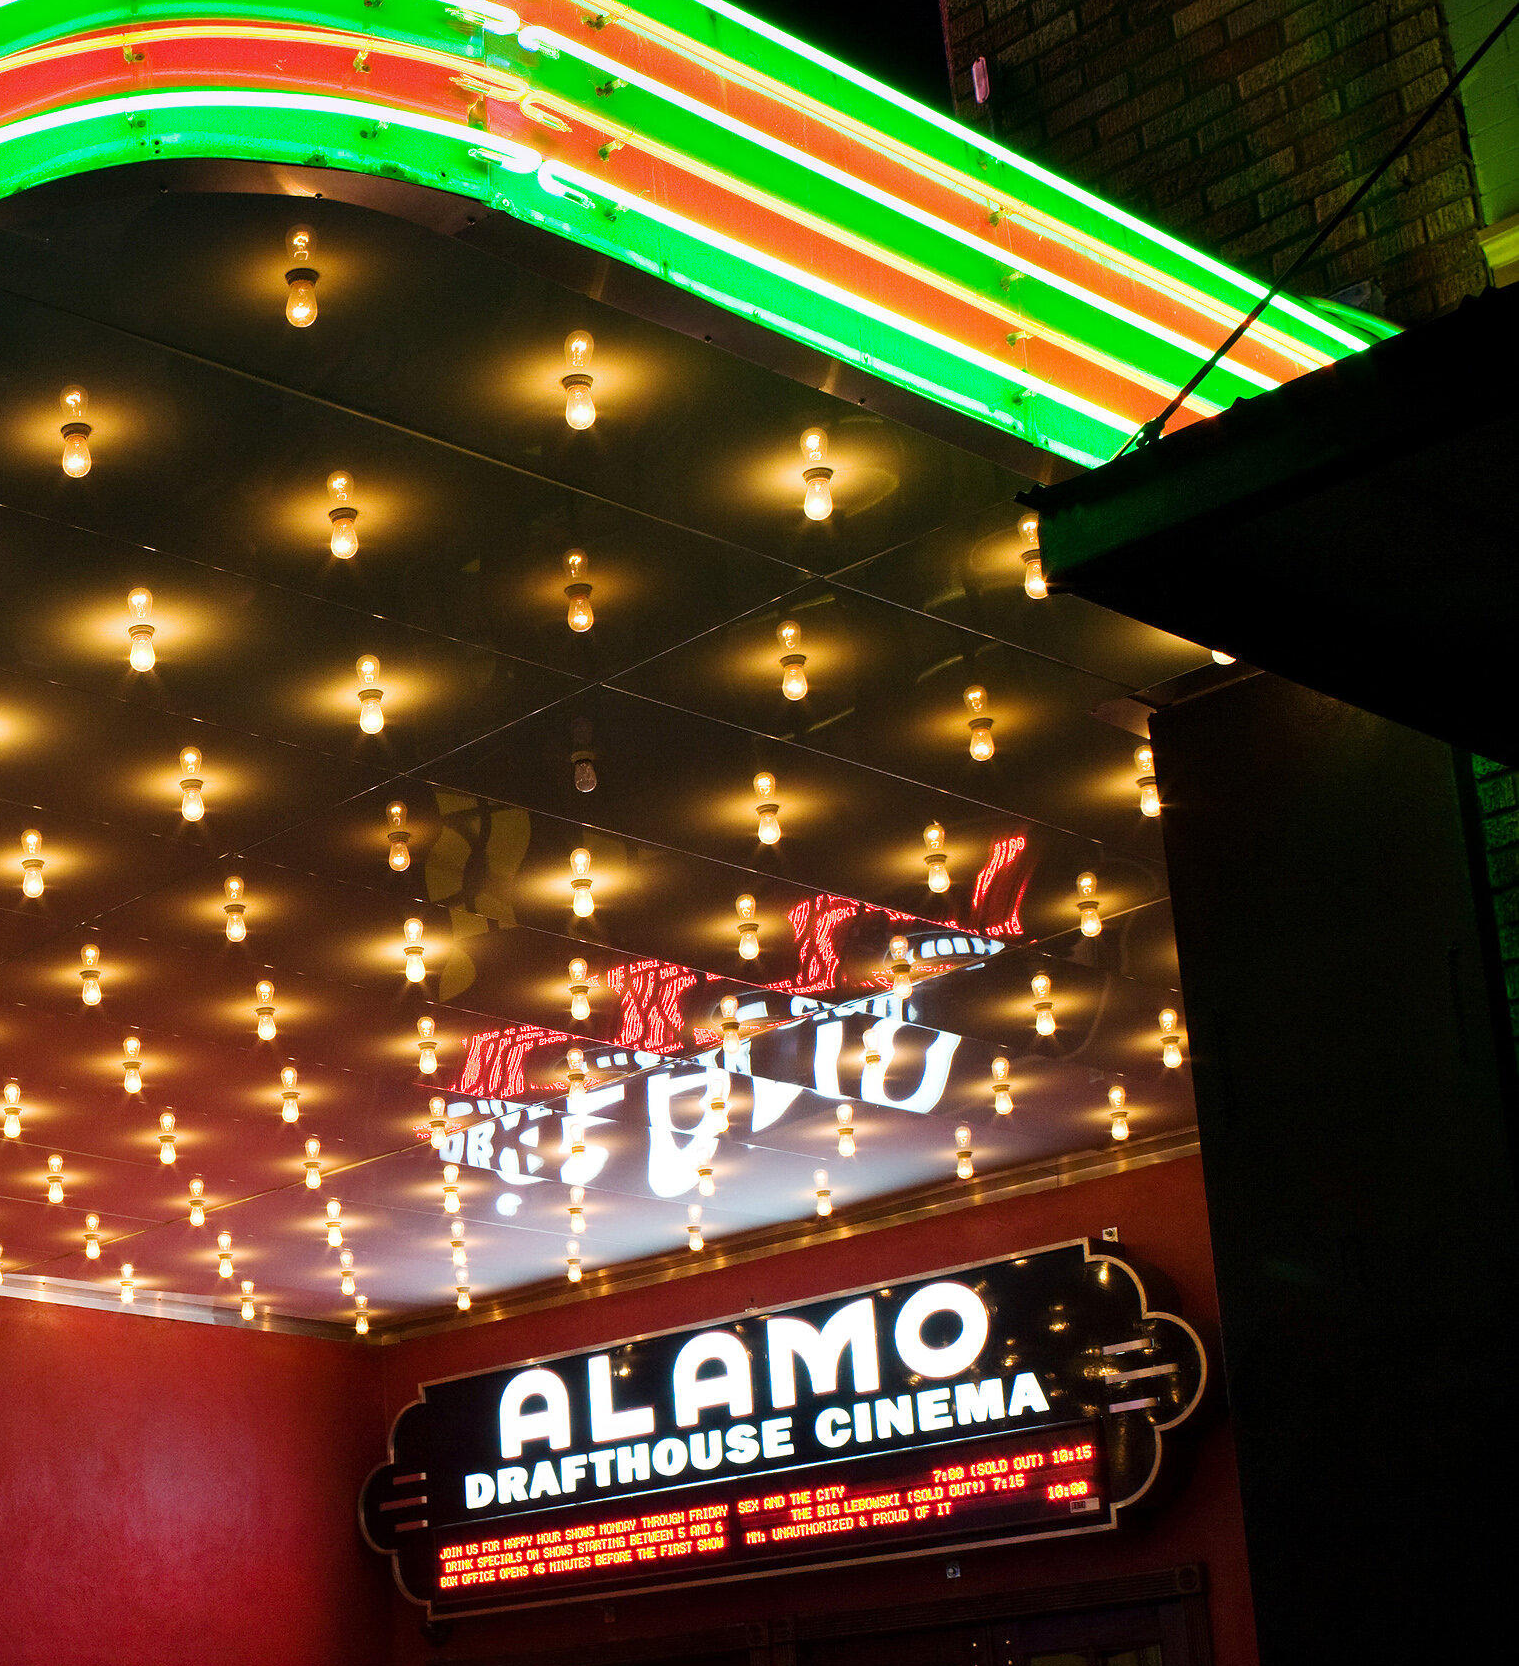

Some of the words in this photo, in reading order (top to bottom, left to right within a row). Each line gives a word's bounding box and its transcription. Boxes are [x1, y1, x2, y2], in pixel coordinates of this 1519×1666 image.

[499, 1281, 989, 1459] ALAMO
[465, 1418, 794, 1509] DRAFTHOUSE
[814, 1372, 1049, 1449] CINEMA
[738, 1500, 759, 1514] SEX
[764, 1496, 785, 1510] AND
[790, 1491, 811, 1505] THE
[816, 1486, 844, 1501] CITY
[772, 1517, 853, 1540] UNAUTHORIZED
[873, 1509, 910, 1525] PROUD
[915, 1506, 930, 1519] OF
[937, 1503, 952, 1515] IT
[790, 1508, 812, 1520] THE
[817, 1504, 839, 1516] BIG
[844, 1494, 900, 1512] LEBOWSKI
[440, 1546, 462, 1559] JOIN
[466, 1544, 478, 1555] US
[483, 1541, 500, 1553] FOR
[504, 1536, 532, 1550] HAPPY
[537, 1531, 561, 1545] HOUR
[565, 1526, 595, 1540] SHOWS
[599, 1519, 636, 1535] MONDAY
[642, 1512, 684, 1529] THROUGH
[690, 1505, 728, 1522] FRIDAY
[446, 1559, 474, 1573] DRINK
[478, 1552, 522, 1568] SPECIALS
[527, 1549, 539, 1561] ON
[543, 1544, 573, 1559] SHOWS
[577, 1536, 625, 1554] STARTING
[630, 1529, 673, 1546] BETWEEN
[690, 1523, 711, 1537] AND
[441, 1576, 458, 1588] BOX
[462, 1571, 495, 1585] OFFICE
[500, 1566, 528, 1580] OPENS
[533, 1563, 545, 1575] 45
[550, 1556, 591, 1572] MINUTES
[595, 1550, 632, 1565] BEFORE
[637, 1547, 655, 1559] THE
[660, 1542, 691, 1556] FIRST
[697, 1537, 723, 1550] SHOW
